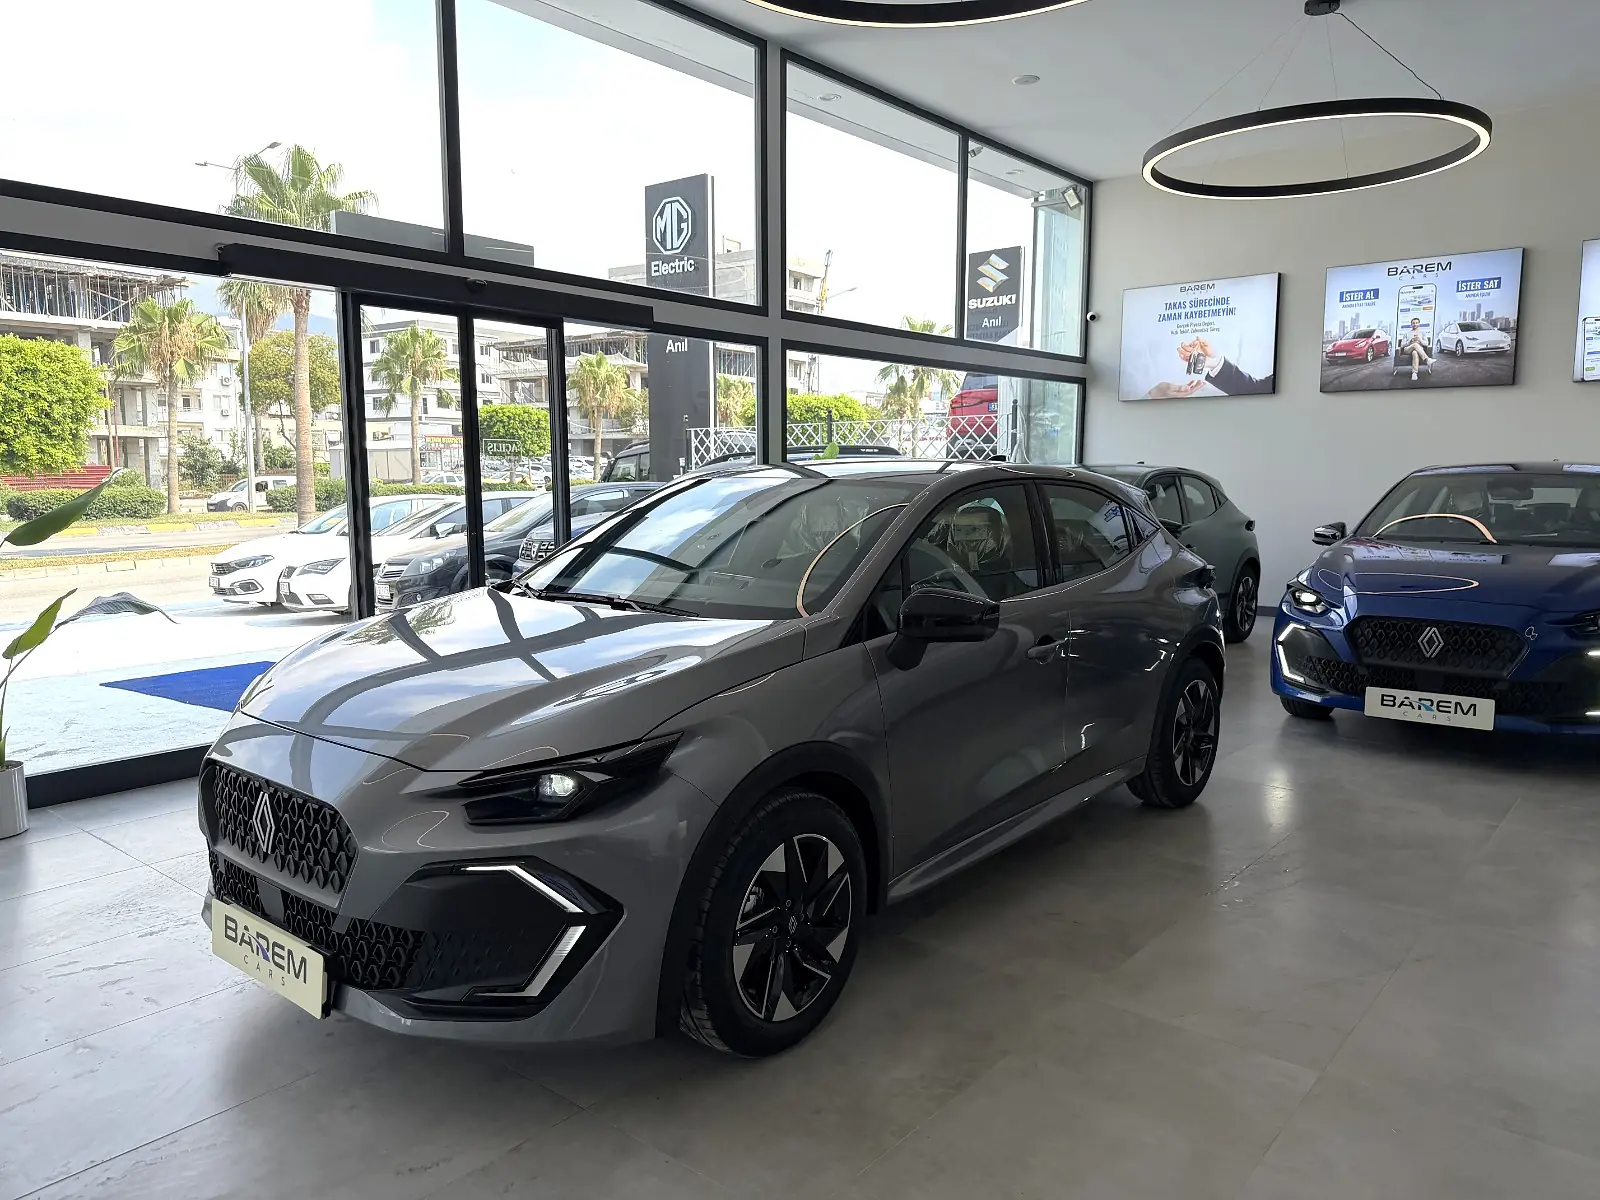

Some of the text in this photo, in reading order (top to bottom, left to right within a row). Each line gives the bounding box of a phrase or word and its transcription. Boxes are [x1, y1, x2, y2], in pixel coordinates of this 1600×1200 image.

[656, 202, 688, 250] MG
[651, 257, 695, 276] Electric
[1387, 261, 1451, 276] BAREM
[1180, 283, 1215, 292] BAREM
[1458, 279, 1499, 291] İSTER SAT
[968, 294, 1016, 309] SUZUKI
[1343, 289, 1375, 301] İSTER AL
[1164, 296, 1230, 311] TAKAS SÜRECİNDE
[1158, 306, 1236, 322] ZAMAN KAYBETMEYİN!
[1381, 694, 1477, 716] BAREM
[1402, 711, 1451, 721] CARS
[225, 914, 306, 984] BAREM
[243, 954, 286, 986] CARS
